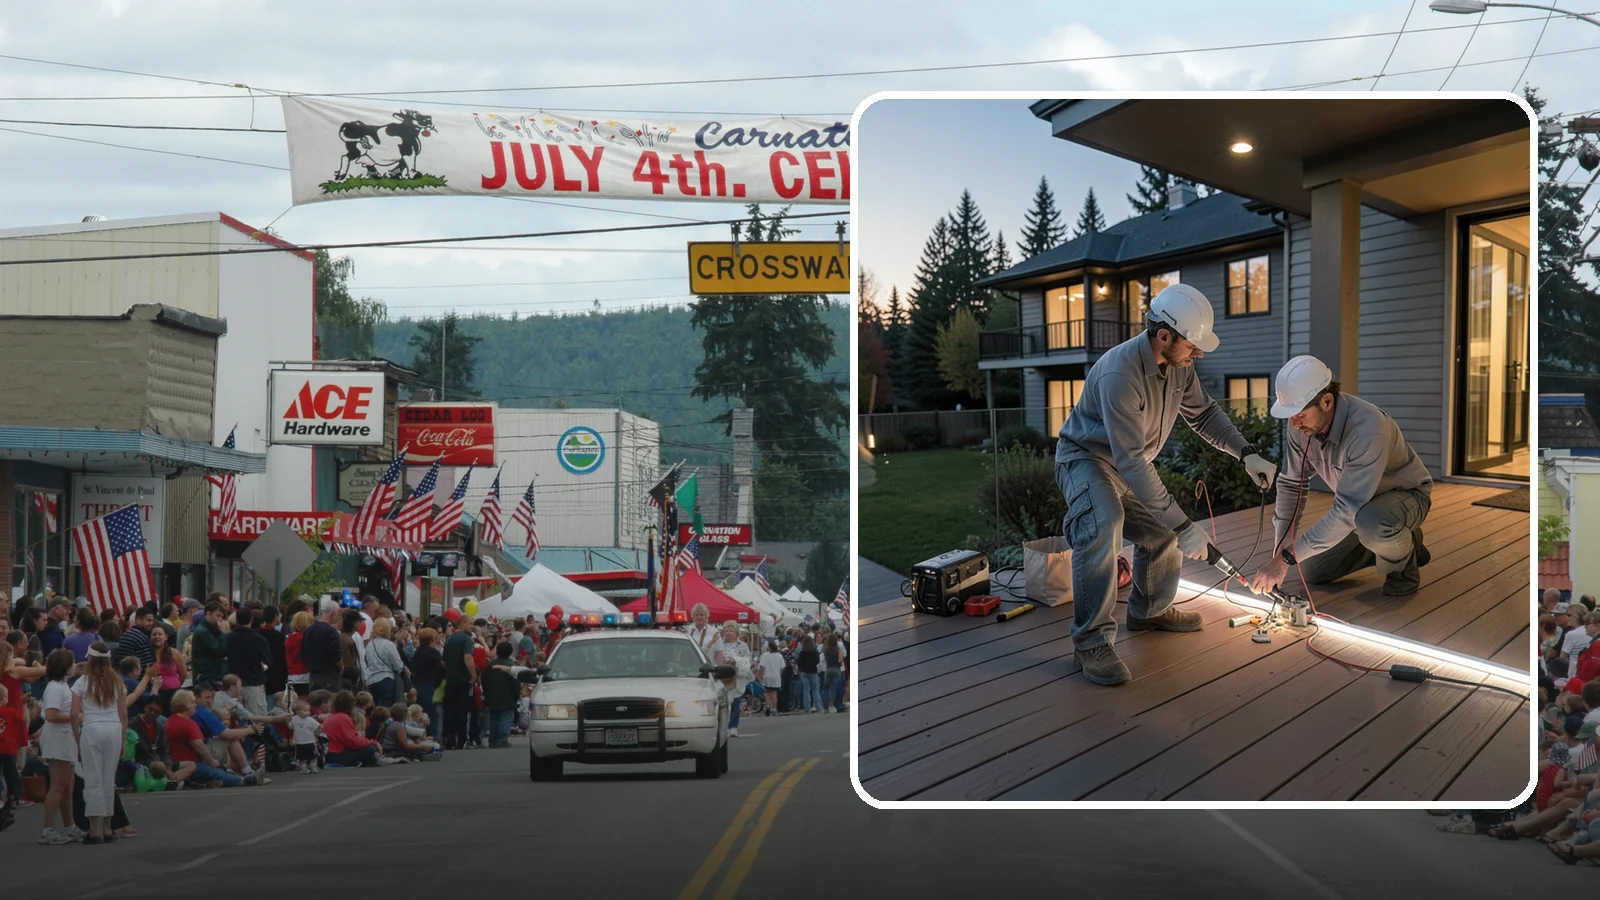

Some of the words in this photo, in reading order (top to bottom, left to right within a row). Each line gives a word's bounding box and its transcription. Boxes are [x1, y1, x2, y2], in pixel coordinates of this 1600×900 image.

[695, 121, 850, 150] Carnat
[481, 141, 605, 192] JULY
[632, 150, 746, 197] 4th.
[697, 253, 850, 280] CROSSWA
[283, 380, 373, 420] ACE
[405, 409, 452, 422] CEDAR
[461, 409, 485, 422] LOG
[283, 421, 371, 437] Hardware
[416, 428, 477, 447] Coca-Cola
[95, 485, 124, 495] Vincent
[126, 486, 136, 495] de
[138, 486, 155, 495] Paul
[212, 516, 331, 536] HARDARE
[688, 526, 741, 535] CRNATION
[699, 535, 730, 544] GLASS
